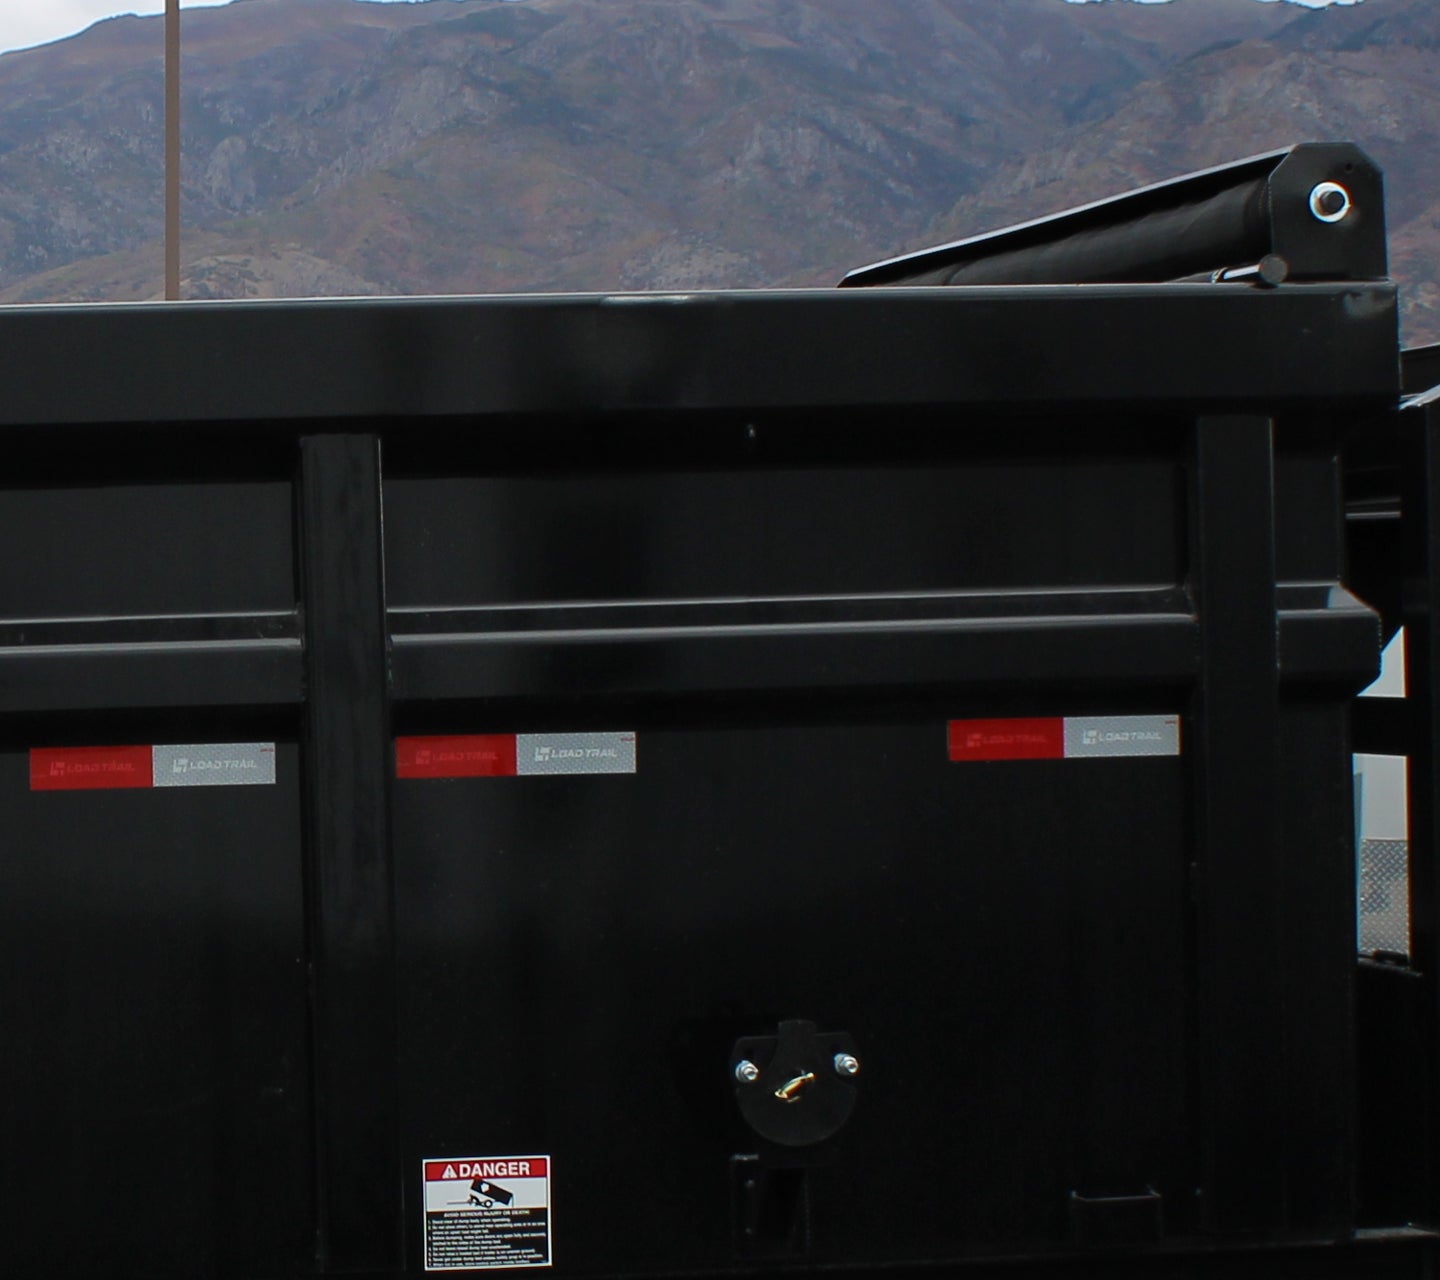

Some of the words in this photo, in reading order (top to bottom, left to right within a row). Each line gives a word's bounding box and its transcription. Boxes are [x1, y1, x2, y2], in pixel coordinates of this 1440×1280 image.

[551, 749, 584, 758] LOAD
[585, 747, 617, 758] TRAIL
[190, 760, 223, 770] LOAD
[224, 759, 257, 769] TRAIL
[460, 1162, 530, 1177] DANGER
